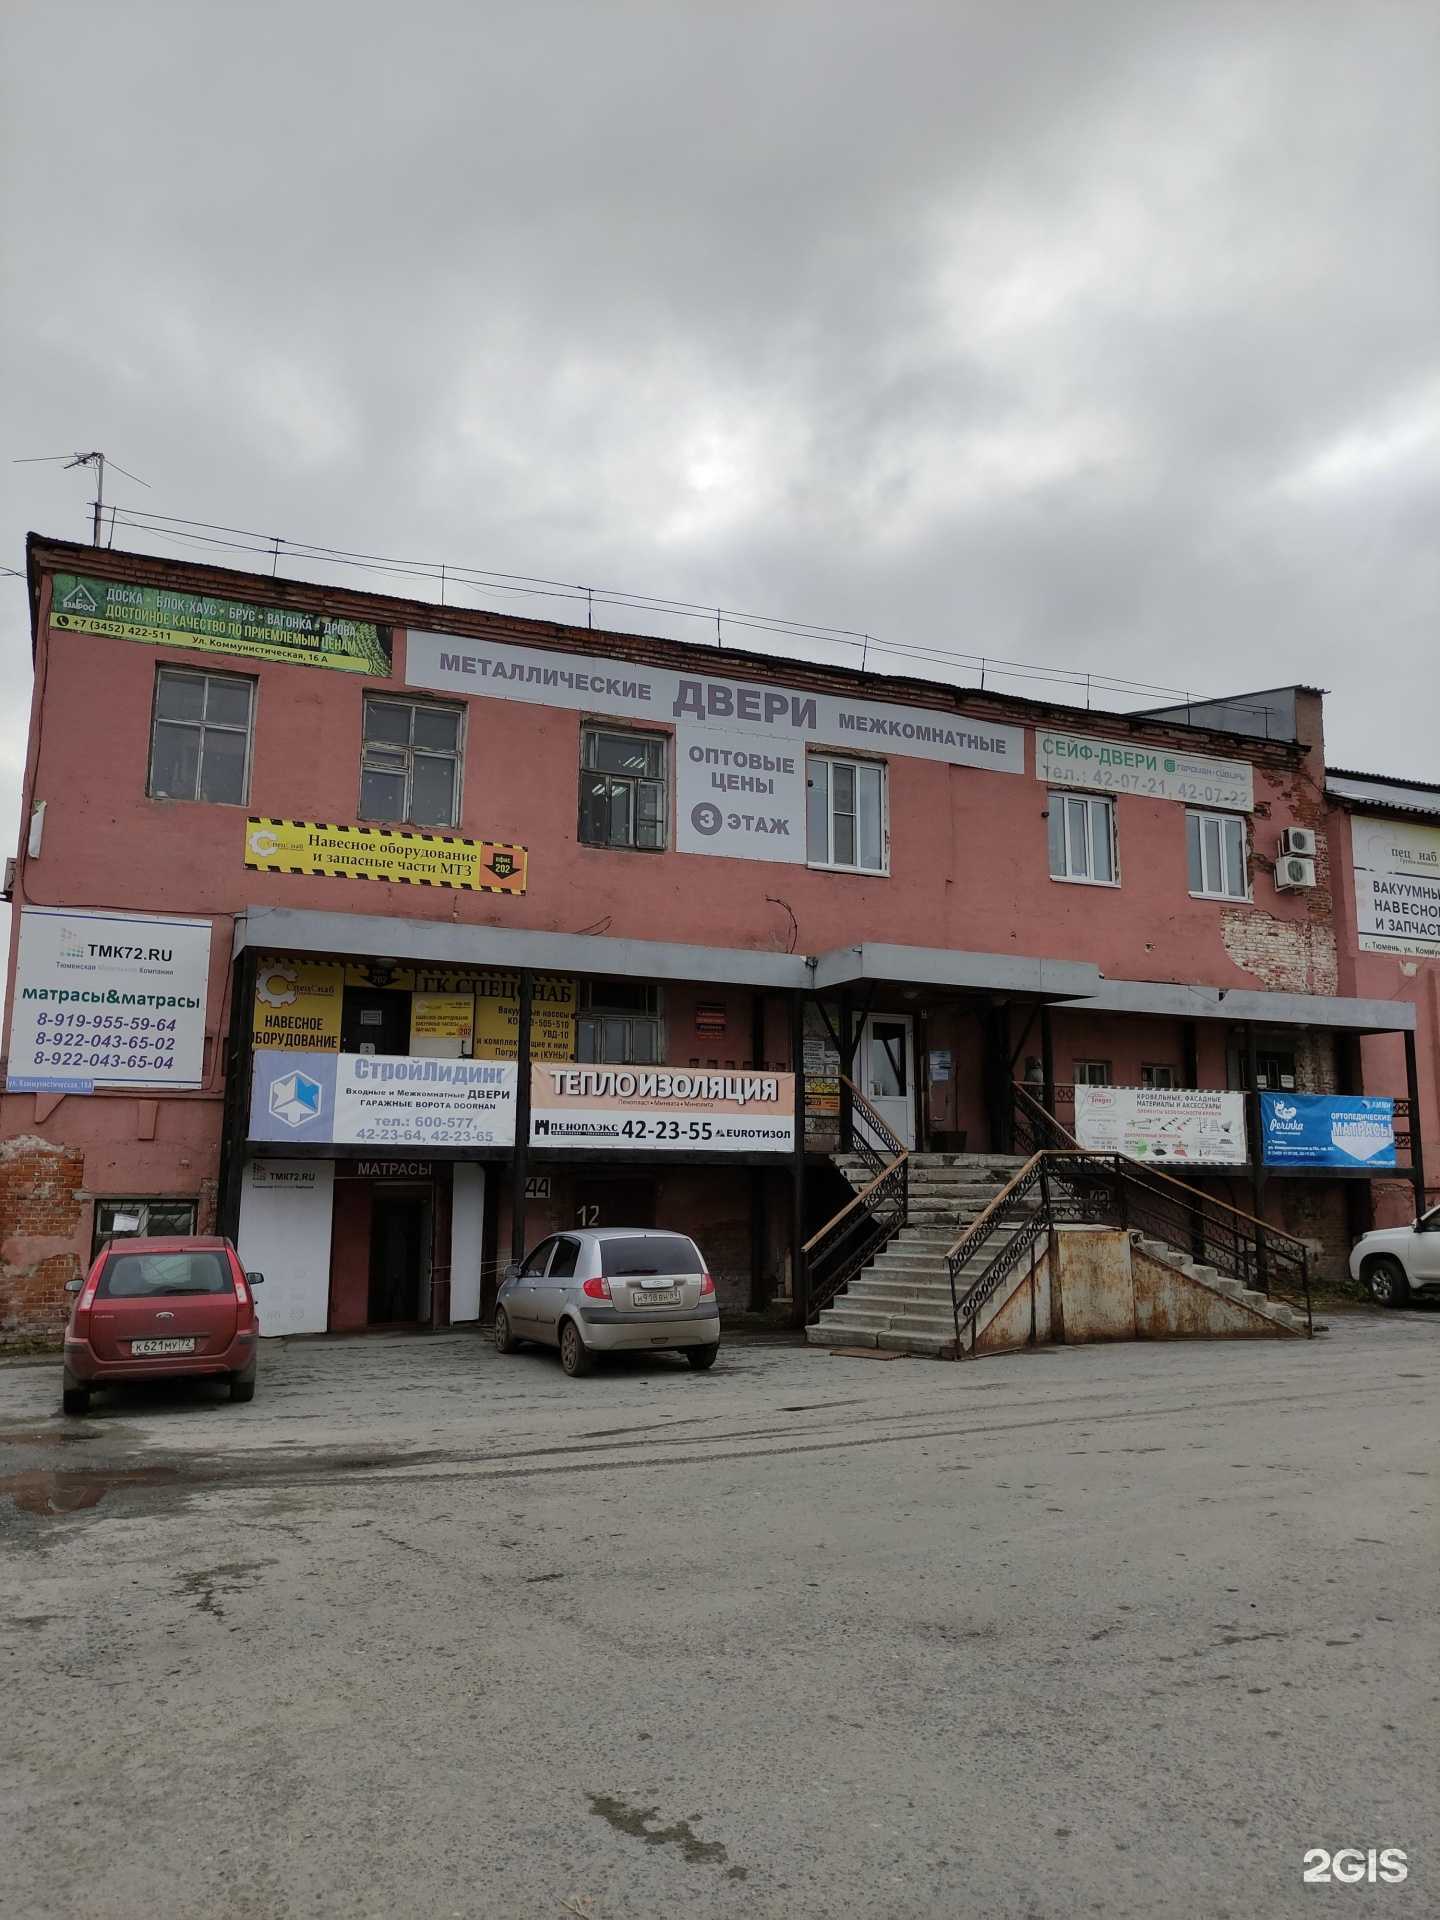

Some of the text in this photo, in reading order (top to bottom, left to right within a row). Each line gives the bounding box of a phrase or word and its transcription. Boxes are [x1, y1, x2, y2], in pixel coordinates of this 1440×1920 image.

[107, 588, 356, 637] ДОСКА БЛОК-ХАУС БРУС ВАГОНКА ДРОВА
[73, 619, 86, 628] +7
[90, 619, 125, 635] (3452)
[128, 627, 172, 640] 422-511
[210, 638, 306, 661] Коммунистическая,
[309, 654, 320, 663] 16
[172, 613, 226, 632] КАЧЕСТВО
[228, 621, 242, 636] ПО
[244, 625, 320, 648] ПРИЕМЛЕМЫМ
[321, 635, 357, 653] ЦЕНАМ
[439, 653, 652, 701] МЕТАЛЛИЧЕСКИЕ
[672, 680, 817, 730] ДВЕРИ
[838, 713, 1007, 755] МЕЖКОМНАТНЫЕ
[688, 745, 795, 775] ОПТОВЫЕ
[1042, 738, 1157, 772] СЕЙФ-ДВЕРИ
[711, 772, 775, 795] ЦЕНЫ
[727, 813, 790, 835] ЭТАЖ
[308, 834, 478, 864] Навесное оборудование
[313, 853, 473, 877] и запасные части МТЗ
[495, 863, 511, 874] 202
[1374, 899, 1440, 918] НАВЕСНО
[1375, 917, 1384, 931] И
[88, 944, 173, 962] TMK72.RU
[22, 987, 200, 1010] матрасы&матрасы
[456, 978, 570, 1002] СПЕЦНАБ
[37, 1012, 176, 1032] 8-919-955-59-64
[265, 1015, 323, 1031] НАВЕСНОЕ
[35, 1032, 176, 1051] 8-922-043-65-02
[33, 1051, 174, 1070] 8-922-043-65-04
[354, 1058, 505, 1085] СтройЛидинг
[346, 1088, 386, 1096] Входные
[397, 1089, 465, 1099] Межкомнатные
[467, 1089, 511, 1100] ДВЕРИ
[550, 1069, 779, 1105] ТЕПЛОИЗОЛЯЦИЯ
[360, 1099, 496, 1110] ГАРАЖНЫЕ ВОРОТА DOORHAN
[1136, 1100, 1174, 1108] МАТЕРИАЛЫ
[1182, 1102, 1222, 1110] АКСЕССУАРЫ
[1184, 1095, 1222, 1103] ФАСАДНЫЕ
[374, 1116, 478, 1130] тел.: 600-577,
[551, 1122, 618, 1132] ПЕНОПЛЭКС
[1331, 1112, 1391, 1121] ОРТОПЕДИЧЕСКИЕ
[356, 1128, 493, 1142] 42-23-64, 42-23-65
[621, 1119, 713, 1141] 42-23-55
[1333, 1121, 1393, 1137] МАТРАСЫ
[358, 1161, 432, 1177] МАТРАСЫ
[576, 1204, 600, 1227] 12
